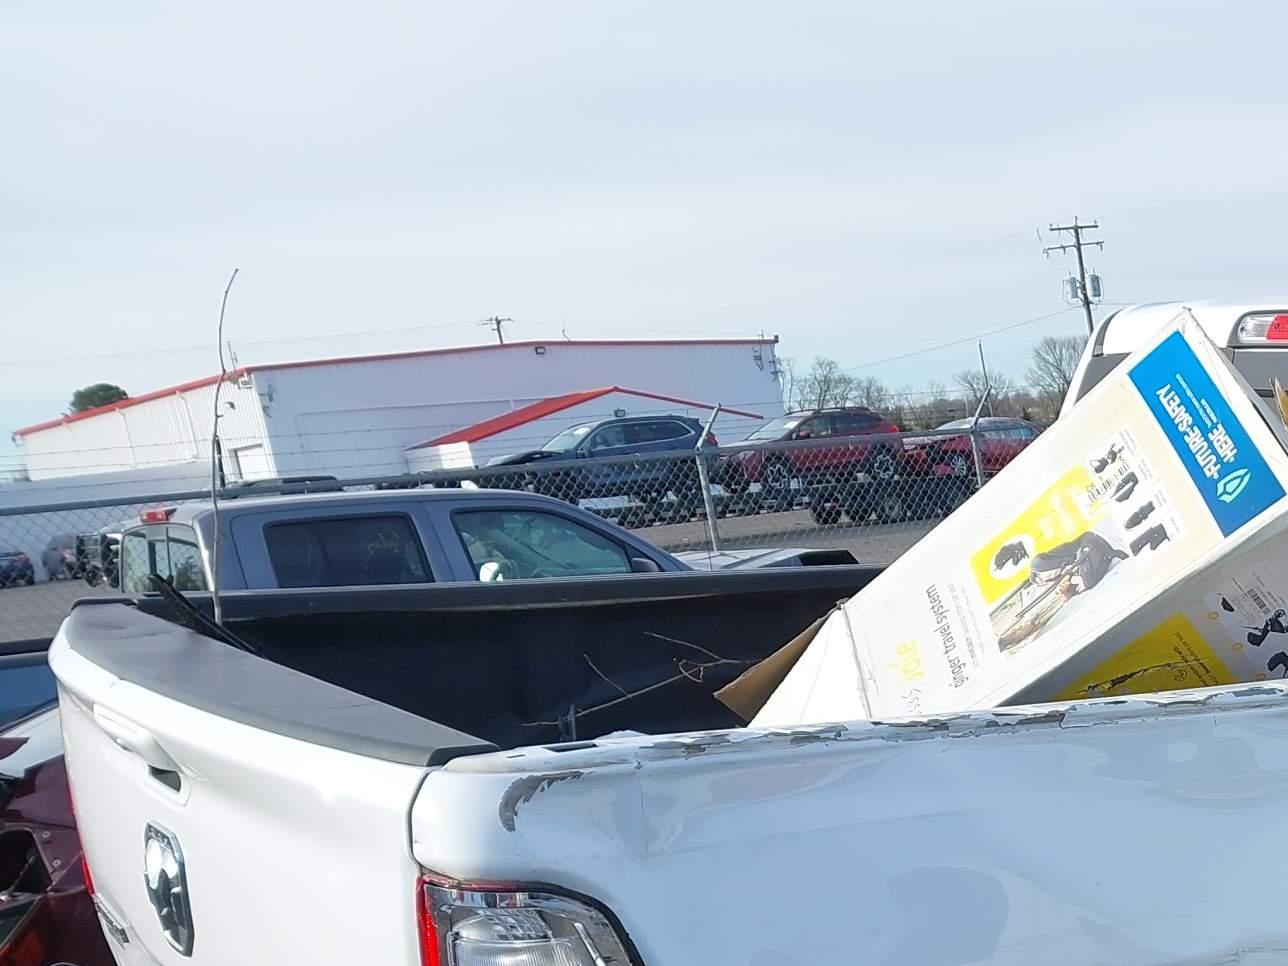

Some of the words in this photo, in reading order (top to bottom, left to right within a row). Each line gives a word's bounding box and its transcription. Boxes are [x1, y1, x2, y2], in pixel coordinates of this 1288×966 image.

[1155, 383, 1193, 432] SAFETY
[1183, 425, 1221, 478] FUTURE
[1207, 423, 1238, 463] HERE
[926, 584, 947, 628] system
[934, 622, 957, 655] travel
